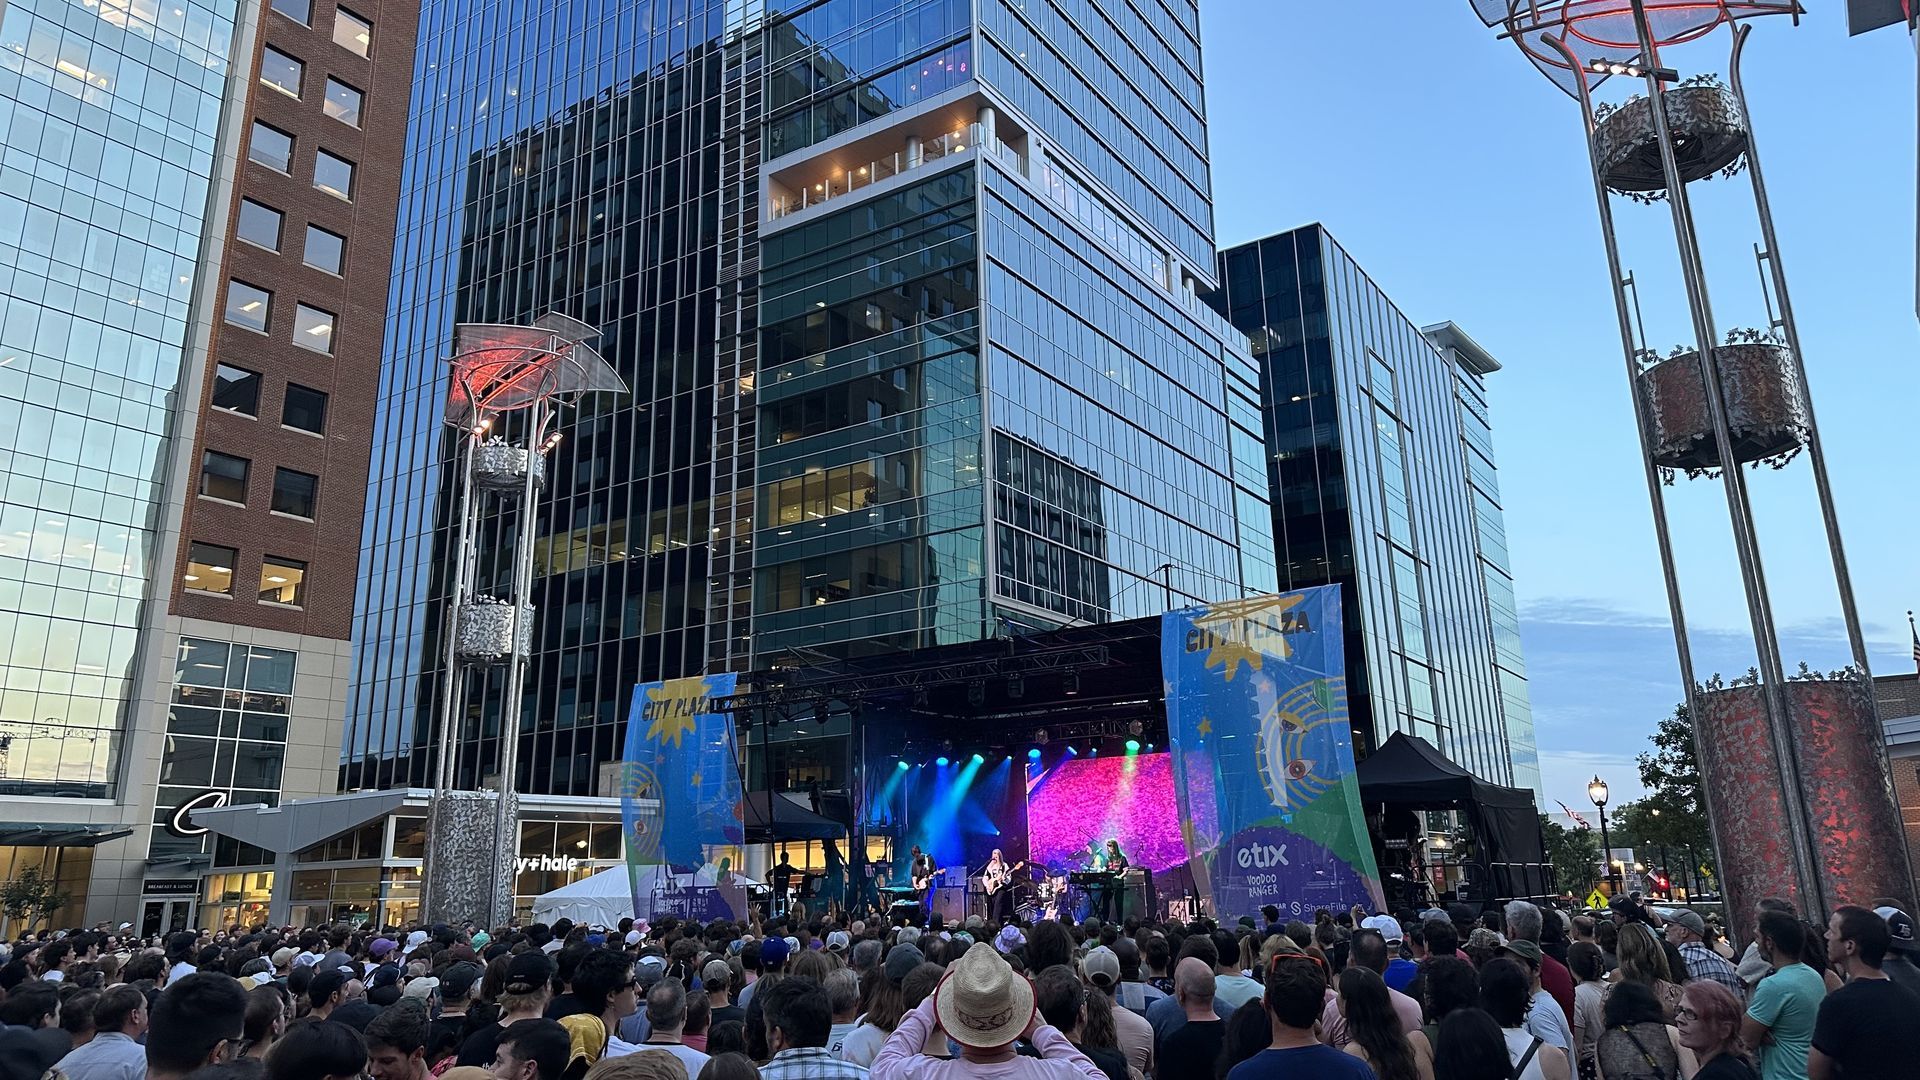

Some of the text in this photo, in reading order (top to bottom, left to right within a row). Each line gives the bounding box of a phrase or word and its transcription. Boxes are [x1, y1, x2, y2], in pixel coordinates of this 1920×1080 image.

[1186, 611, 1310, 652] CITY PLAZA
[642, 699, 672, 721] CITY
[1237, 842, 1289, 869] etix
[1247, 873, 1277, 886] VOODOO
[1248, 884, 1279, 898] RANGER
[1304, 902, 1347, 913] ShareFile
